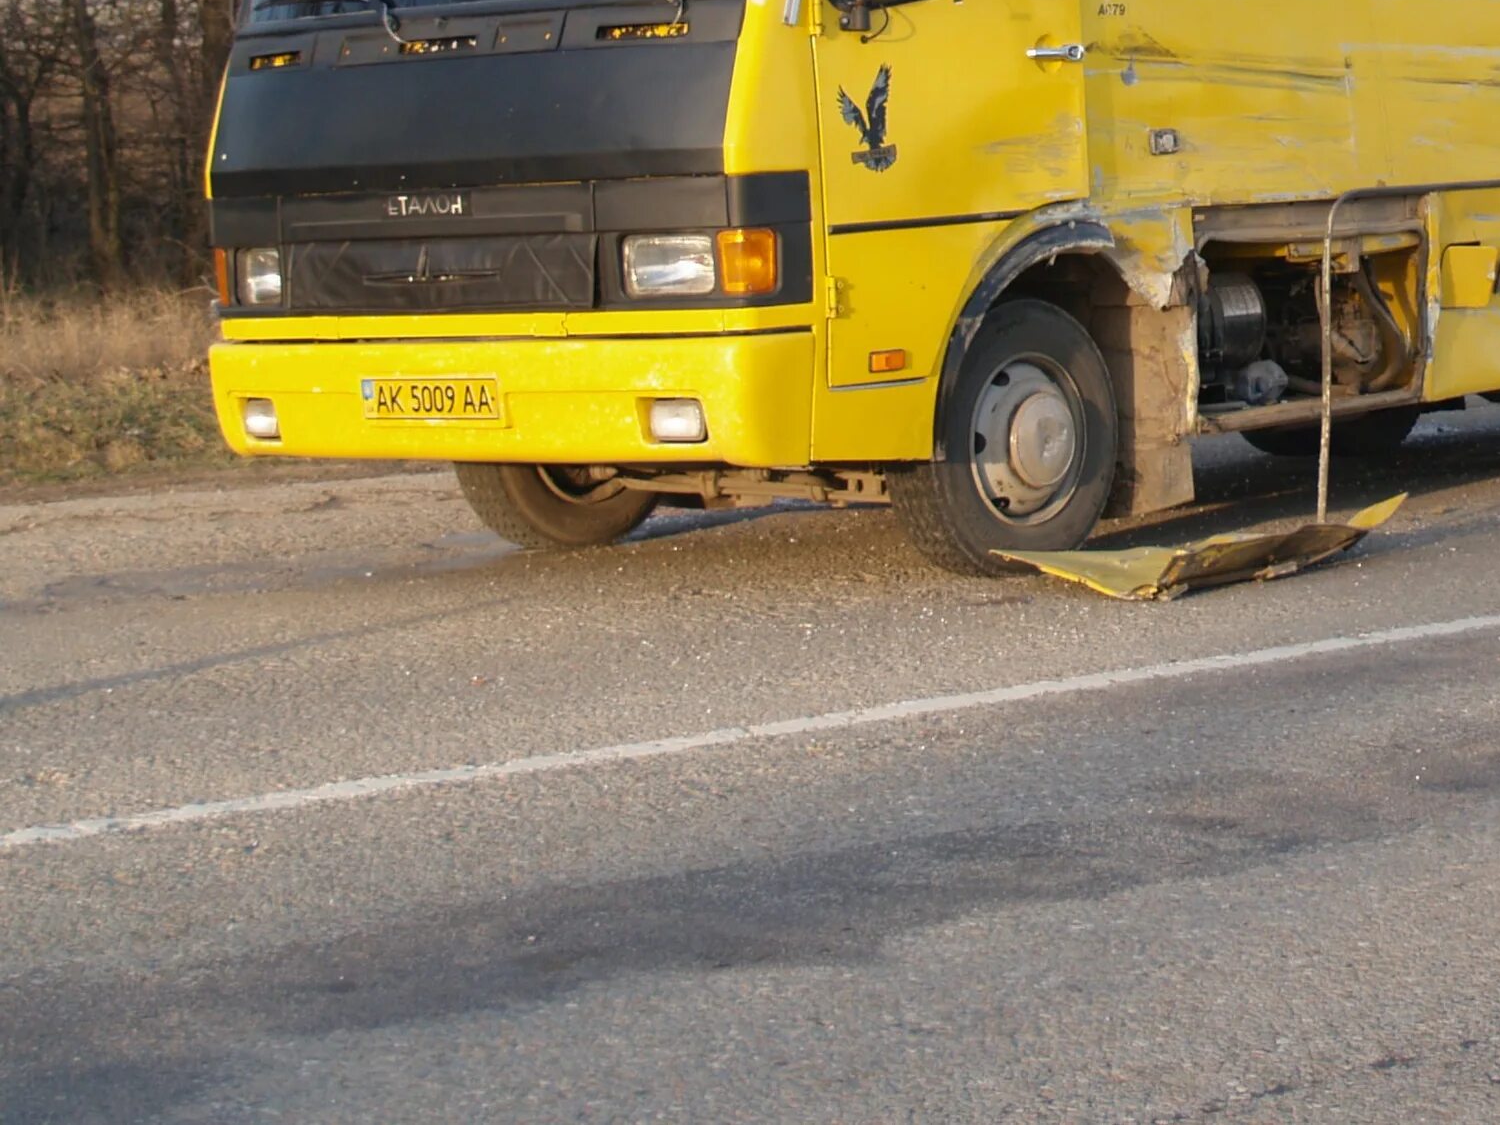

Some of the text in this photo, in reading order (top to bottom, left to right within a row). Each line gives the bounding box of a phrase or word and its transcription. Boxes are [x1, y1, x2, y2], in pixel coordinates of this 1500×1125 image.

[377, 384, 493, 413] AK 5009 AA
